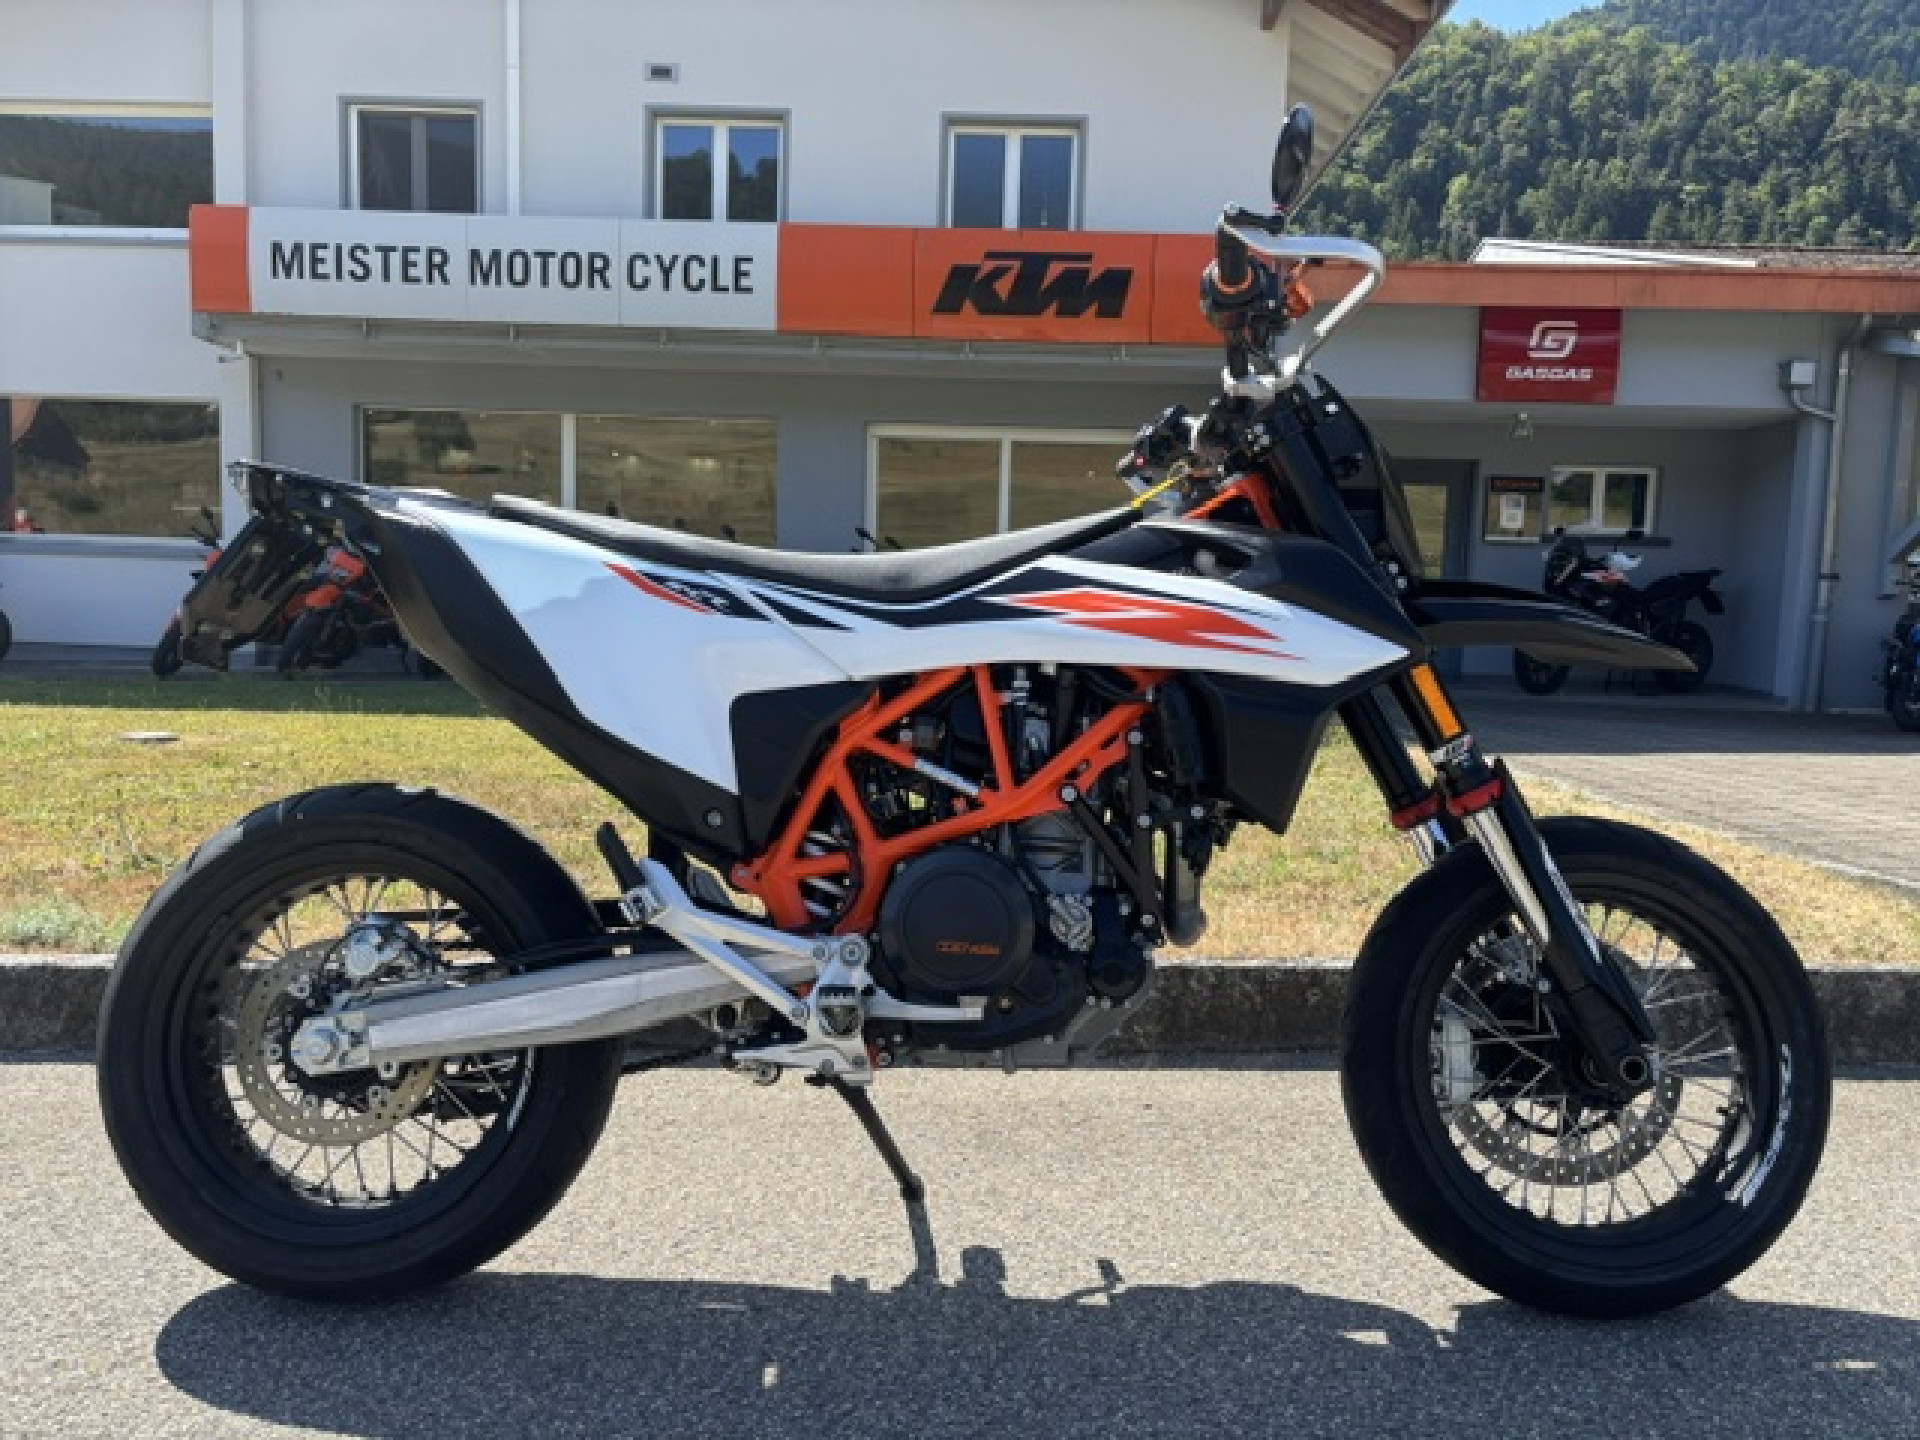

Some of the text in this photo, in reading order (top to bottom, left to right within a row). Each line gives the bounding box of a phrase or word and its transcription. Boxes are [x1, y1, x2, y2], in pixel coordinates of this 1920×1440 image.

[271, 240, 754, 295] MEISTER MOTOR CYCLE
[933, 251, 1133, 318] KTM
[1505, 365, 1593, 382] GASGAS
